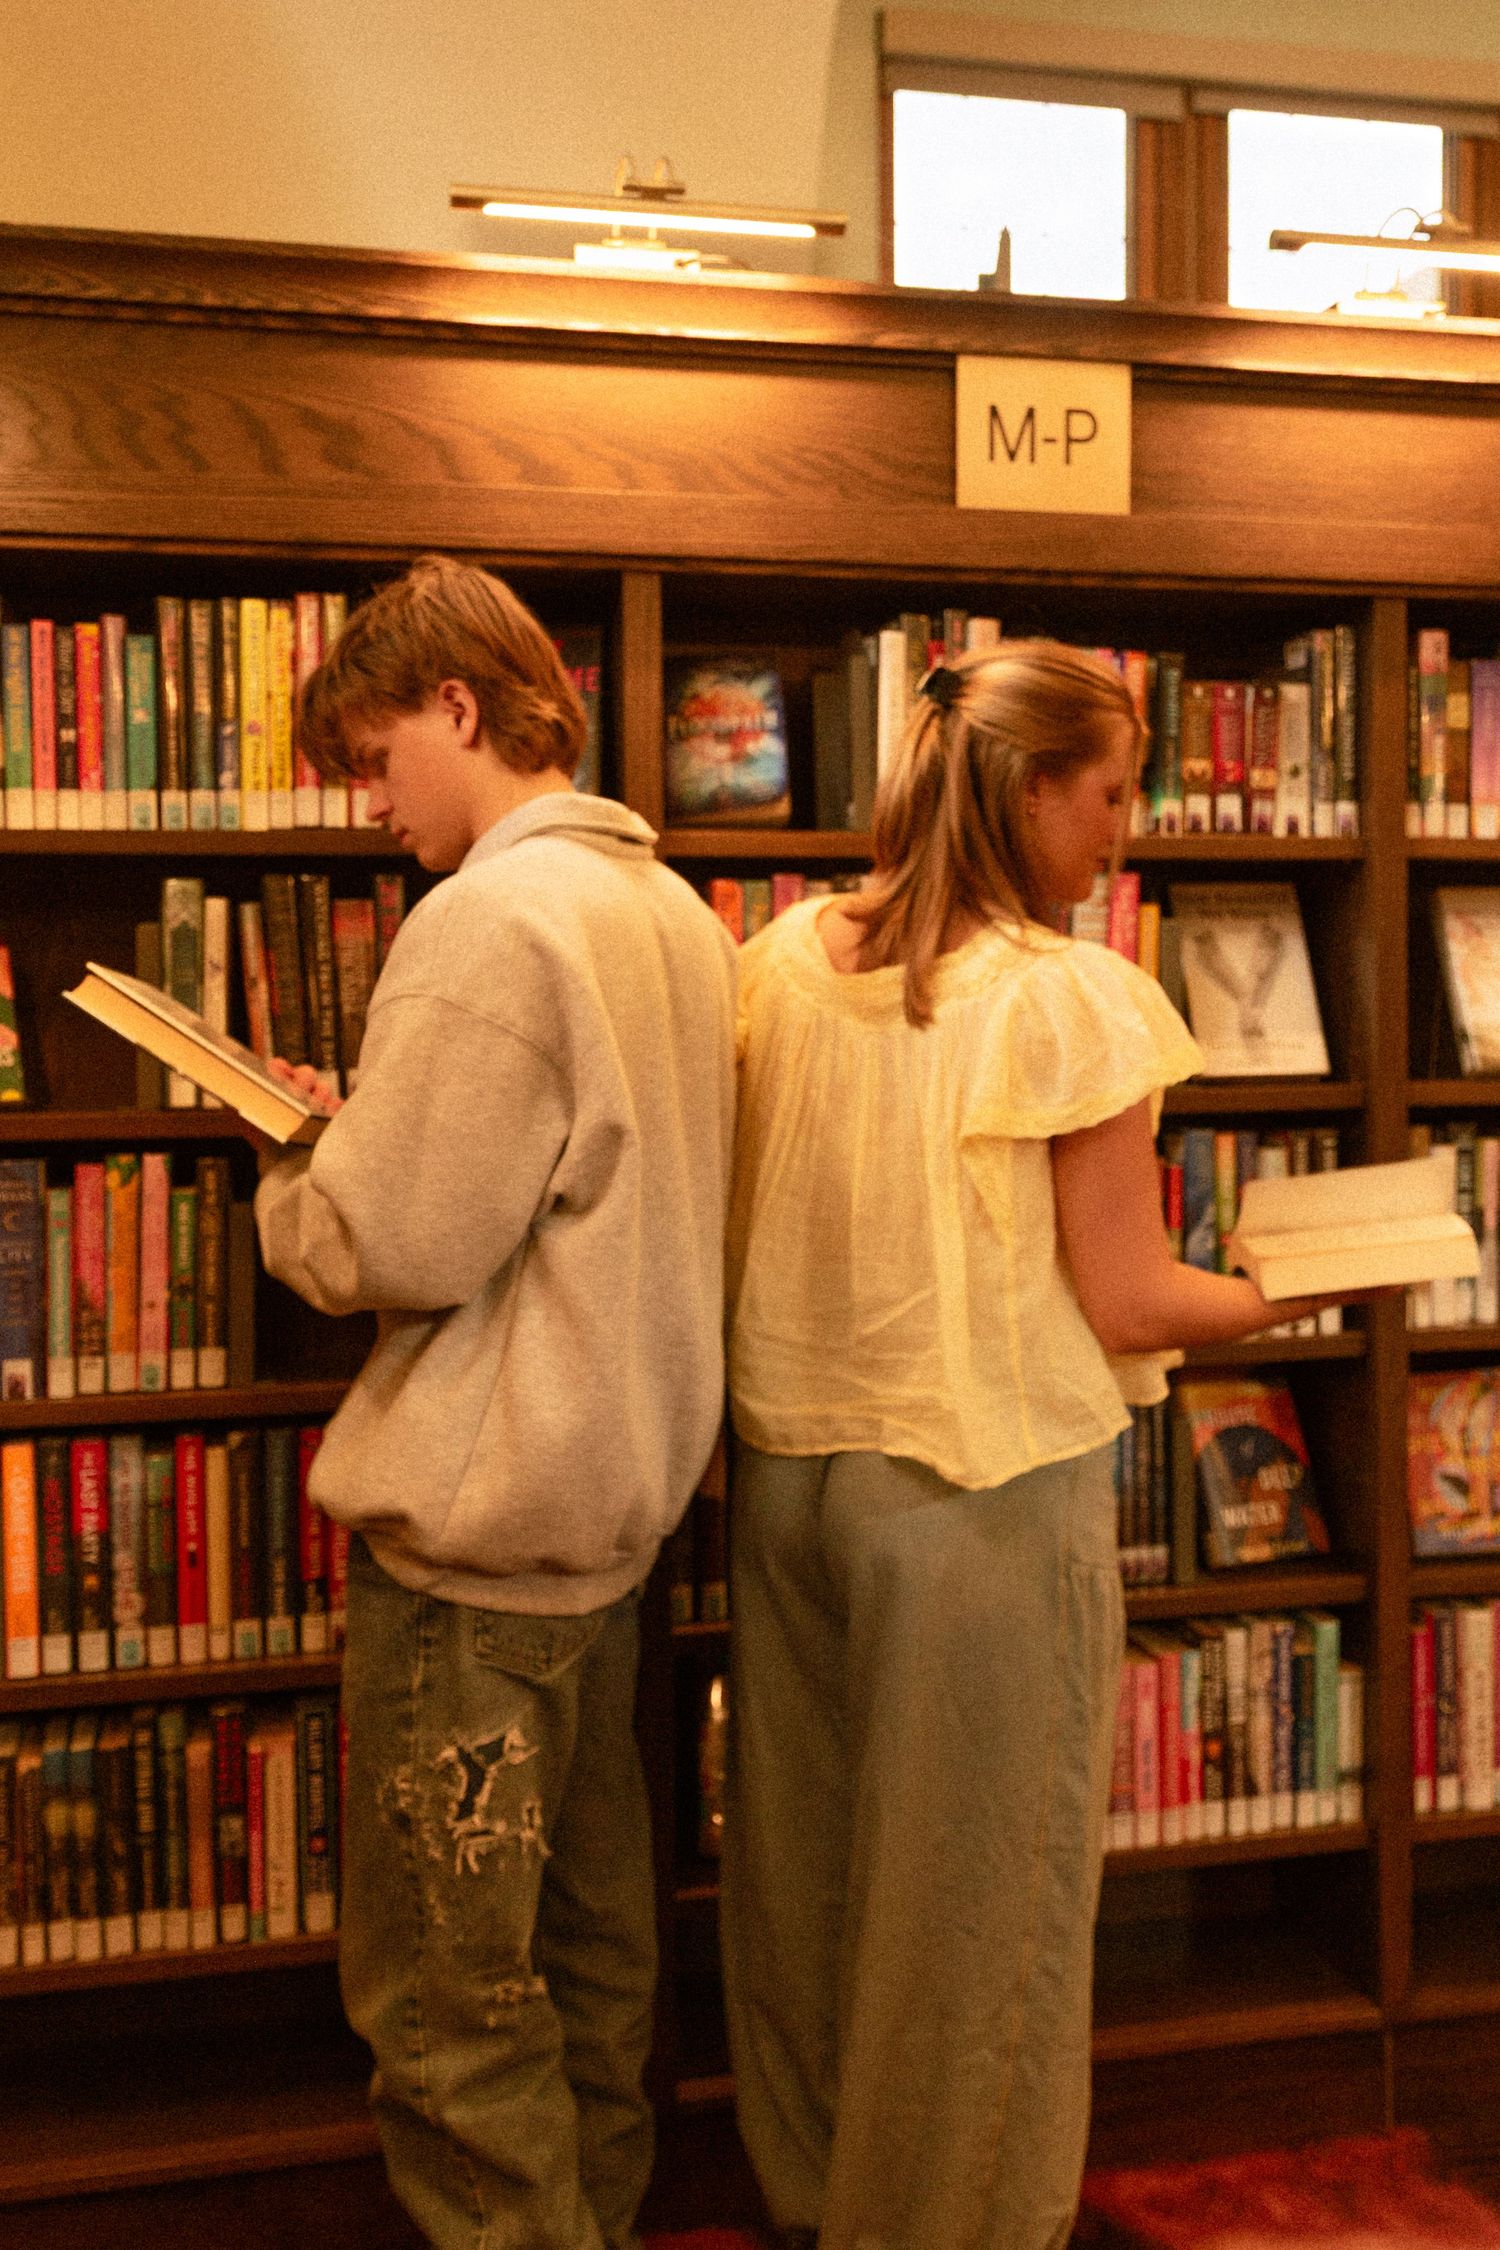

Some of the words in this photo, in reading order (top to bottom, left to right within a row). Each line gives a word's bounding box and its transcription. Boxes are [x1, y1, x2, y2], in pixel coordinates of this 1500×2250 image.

[989, 404, 1098, 465] M-P
[79, 1469, 99, 1510] LAST
[80, 1511, 101, 1564] PARTY
